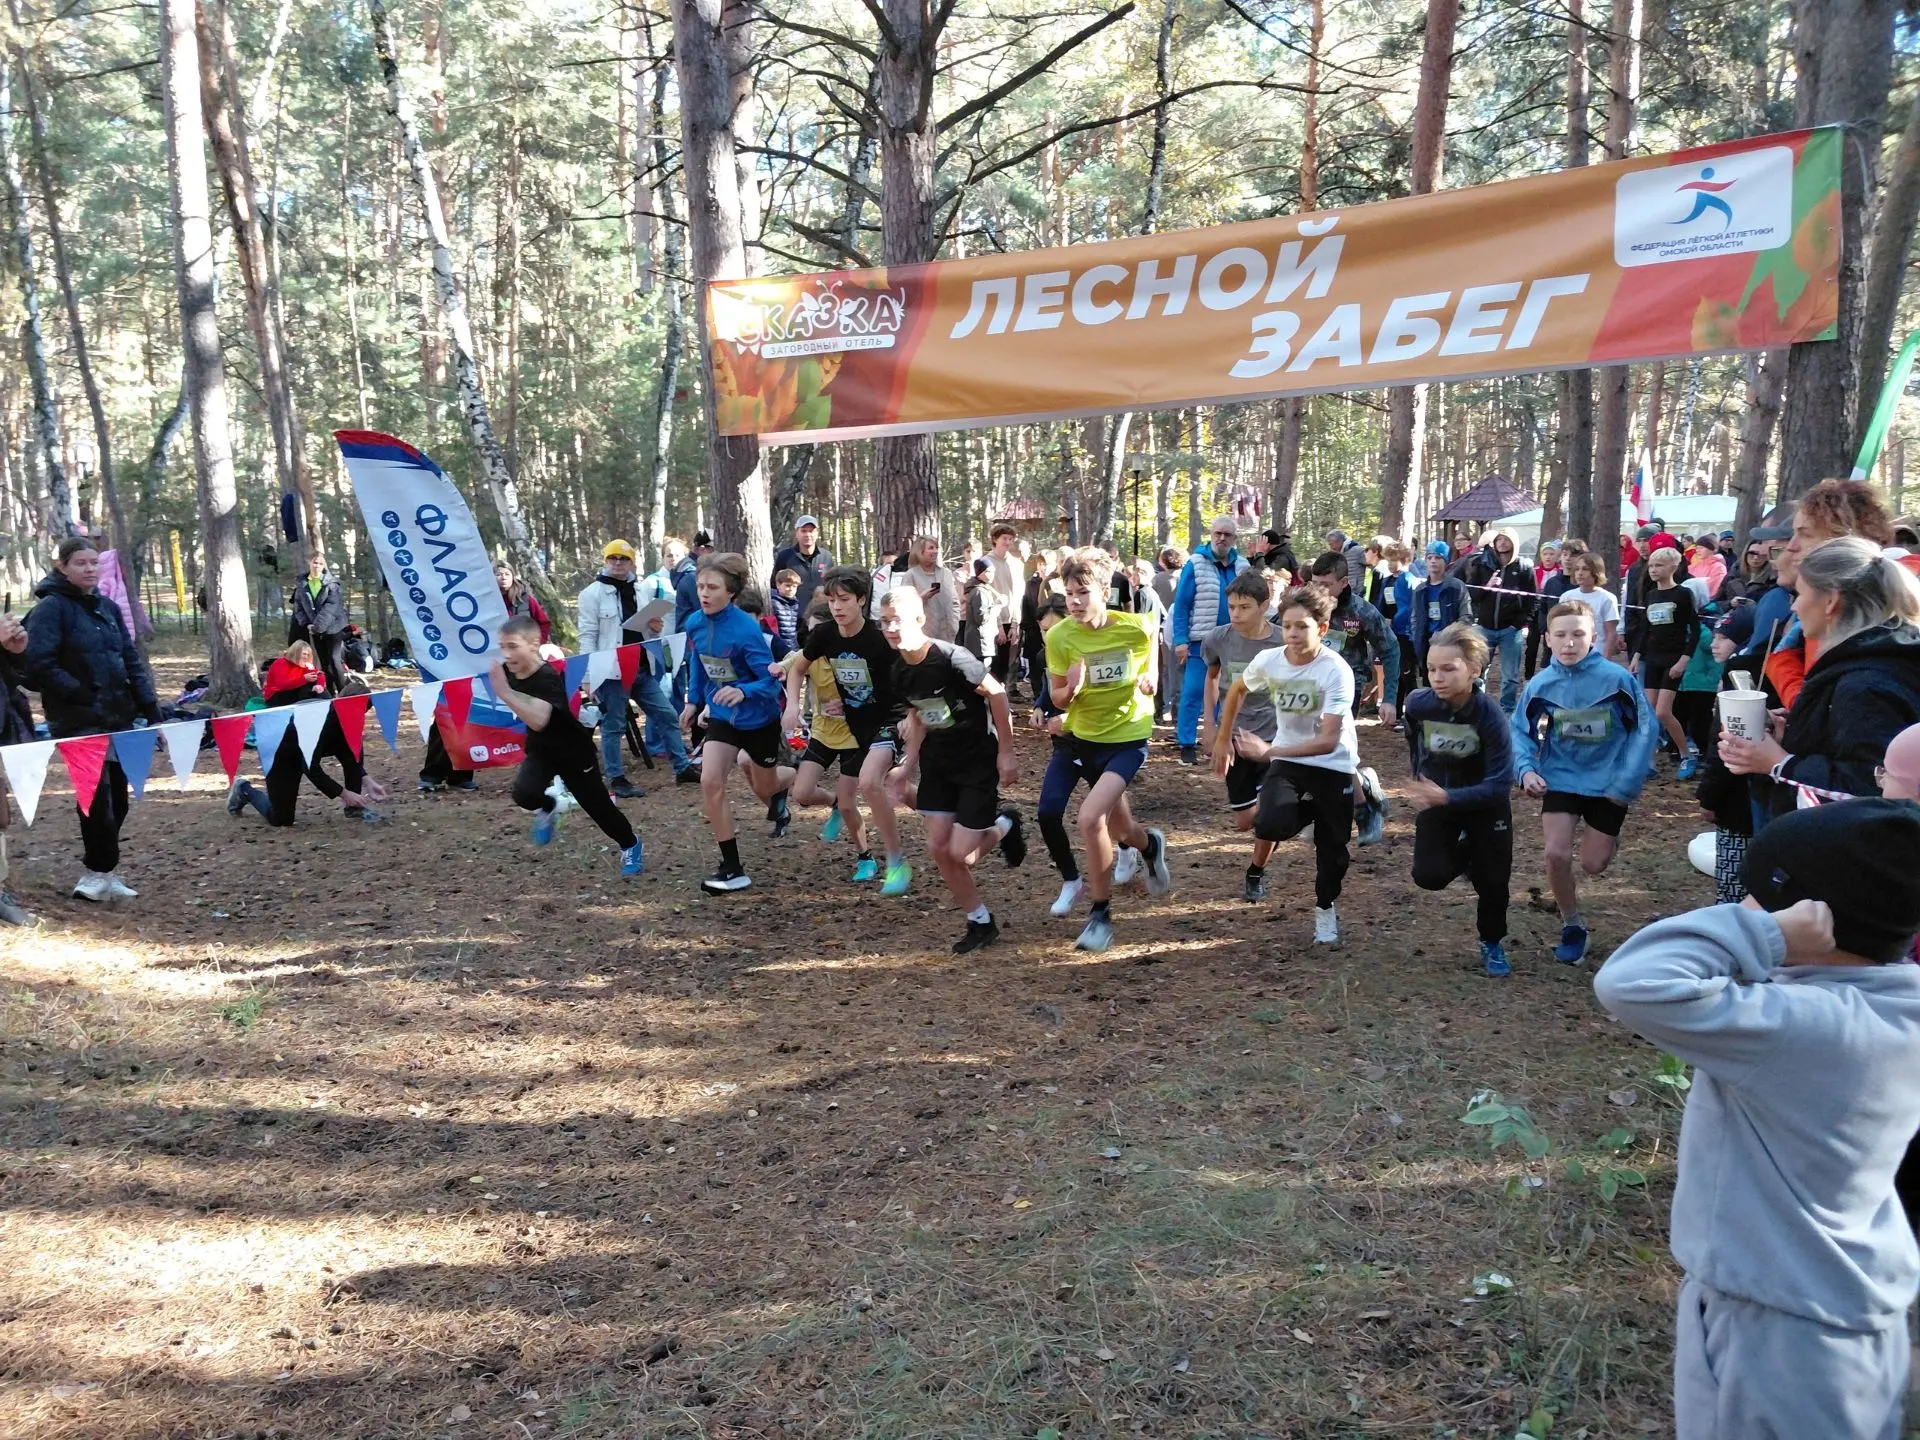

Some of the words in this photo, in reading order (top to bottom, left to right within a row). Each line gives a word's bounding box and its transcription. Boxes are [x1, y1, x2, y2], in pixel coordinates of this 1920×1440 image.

[1630, 237, 1686, 252] ФЕДЕРАЦИЯ
[1687, 232, 1723, 245] ЛЁГКОЙ
[1724, 226, 1774, 239] АТЛЕТИКИ
[1659, 245, 1698, 257] ОМСКОЙ
[1699, 239, 1743, 253] ОБЛАСТИ
[949, 216, 1346, 339] ЛЕСНОЙ
[1229, 273, 1590, 379] ЗАБЕГ
[770, 341, 839, 356] ЗАГОРОДНЫЙ
[845, 337, 883, 349] ОТЕЛЬ
[414, 503, 490, 655] ФЛАОО
[841, 671, 859, 681] 257
[1096, 665, 1123, 680] 124
[1276, 693, 1310, 708] 379
